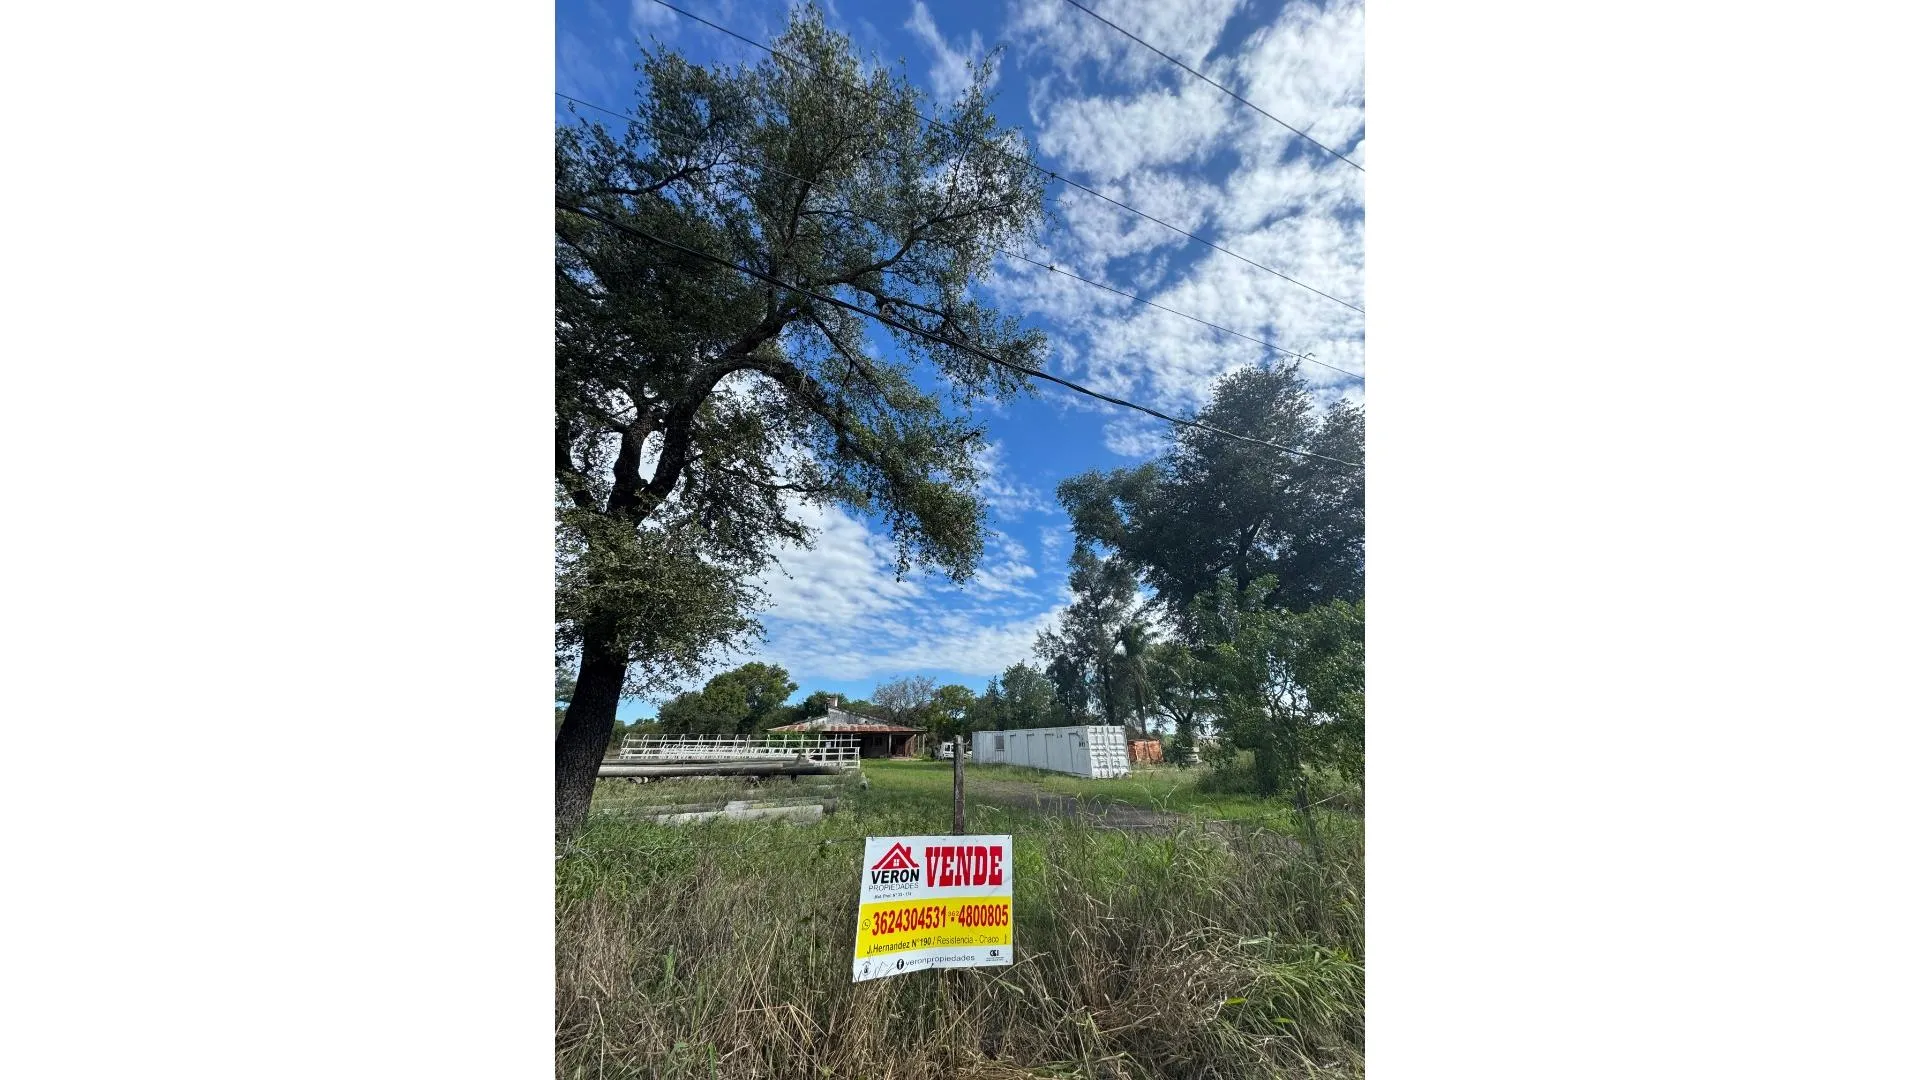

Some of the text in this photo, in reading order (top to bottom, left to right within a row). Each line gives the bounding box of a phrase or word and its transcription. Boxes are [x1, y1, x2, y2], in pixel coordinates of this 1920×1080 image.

[924, 846, 1003, 887] VENDE
[871, 869, 920, 884] VERON
[868, 882, 919, 892] PROPIEDADES
[872, 906, 947, 936] 3624304531
[958, 904, 1009, 927] 4800805
[936, 935, 974, 945] Resistencia
[905, 955, 975, 966] veronpropiedades
